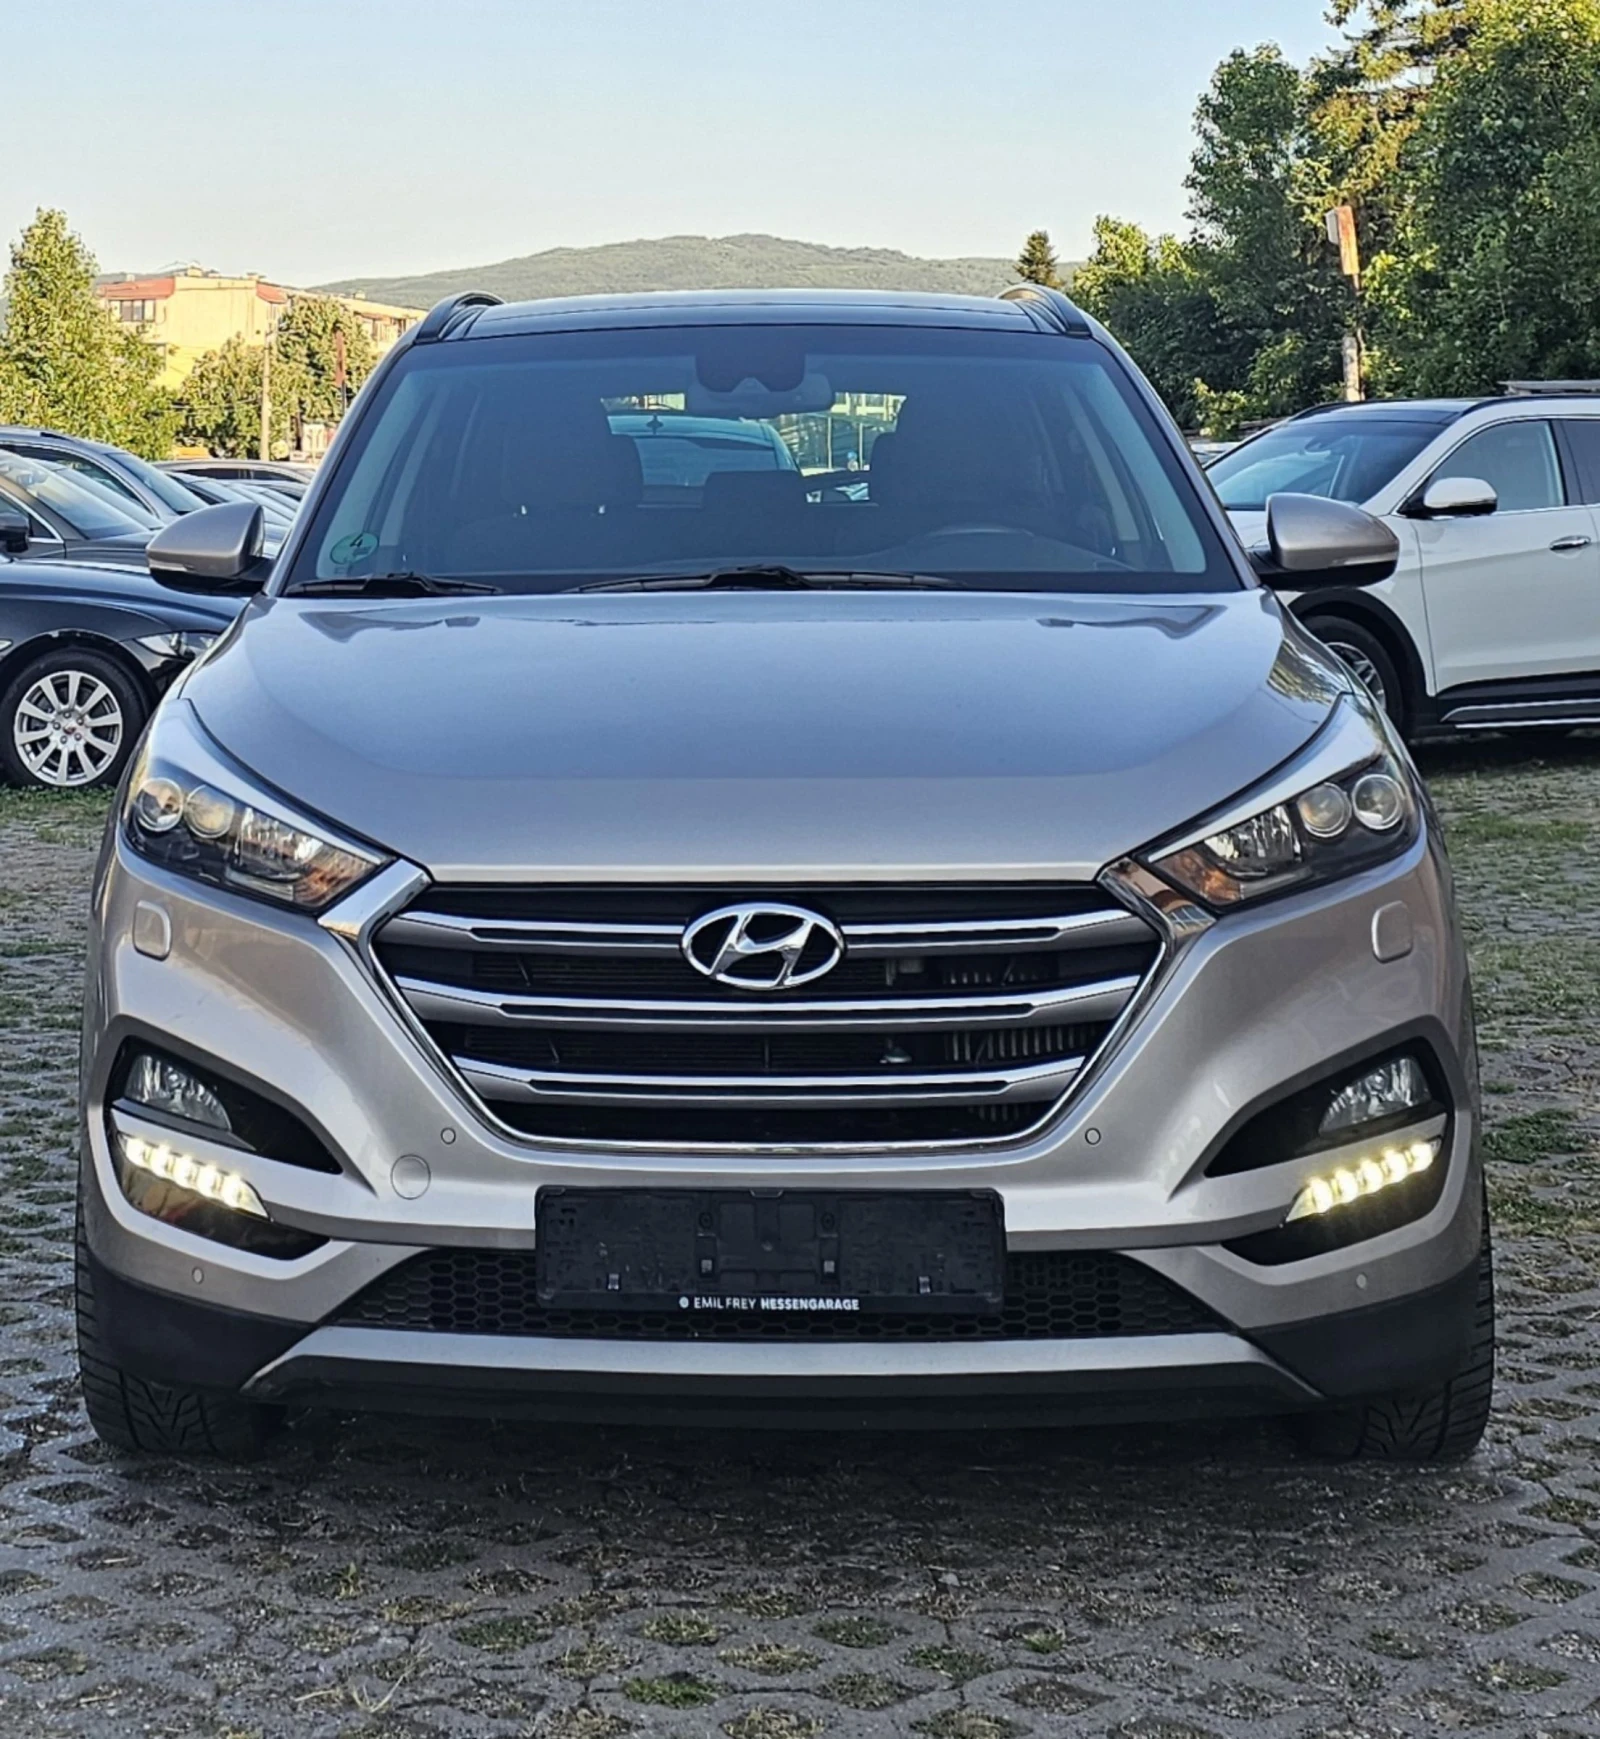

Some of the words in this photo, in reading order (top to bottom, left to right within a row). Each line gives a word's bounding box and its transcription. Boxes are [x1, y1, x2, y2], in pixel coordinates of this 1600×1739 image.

[693, 1296, 725, 1309] EMIL
[725, 1296, 757, 1310] FREY
[760, 1297, 860, 1311] HESSENGARAGE
